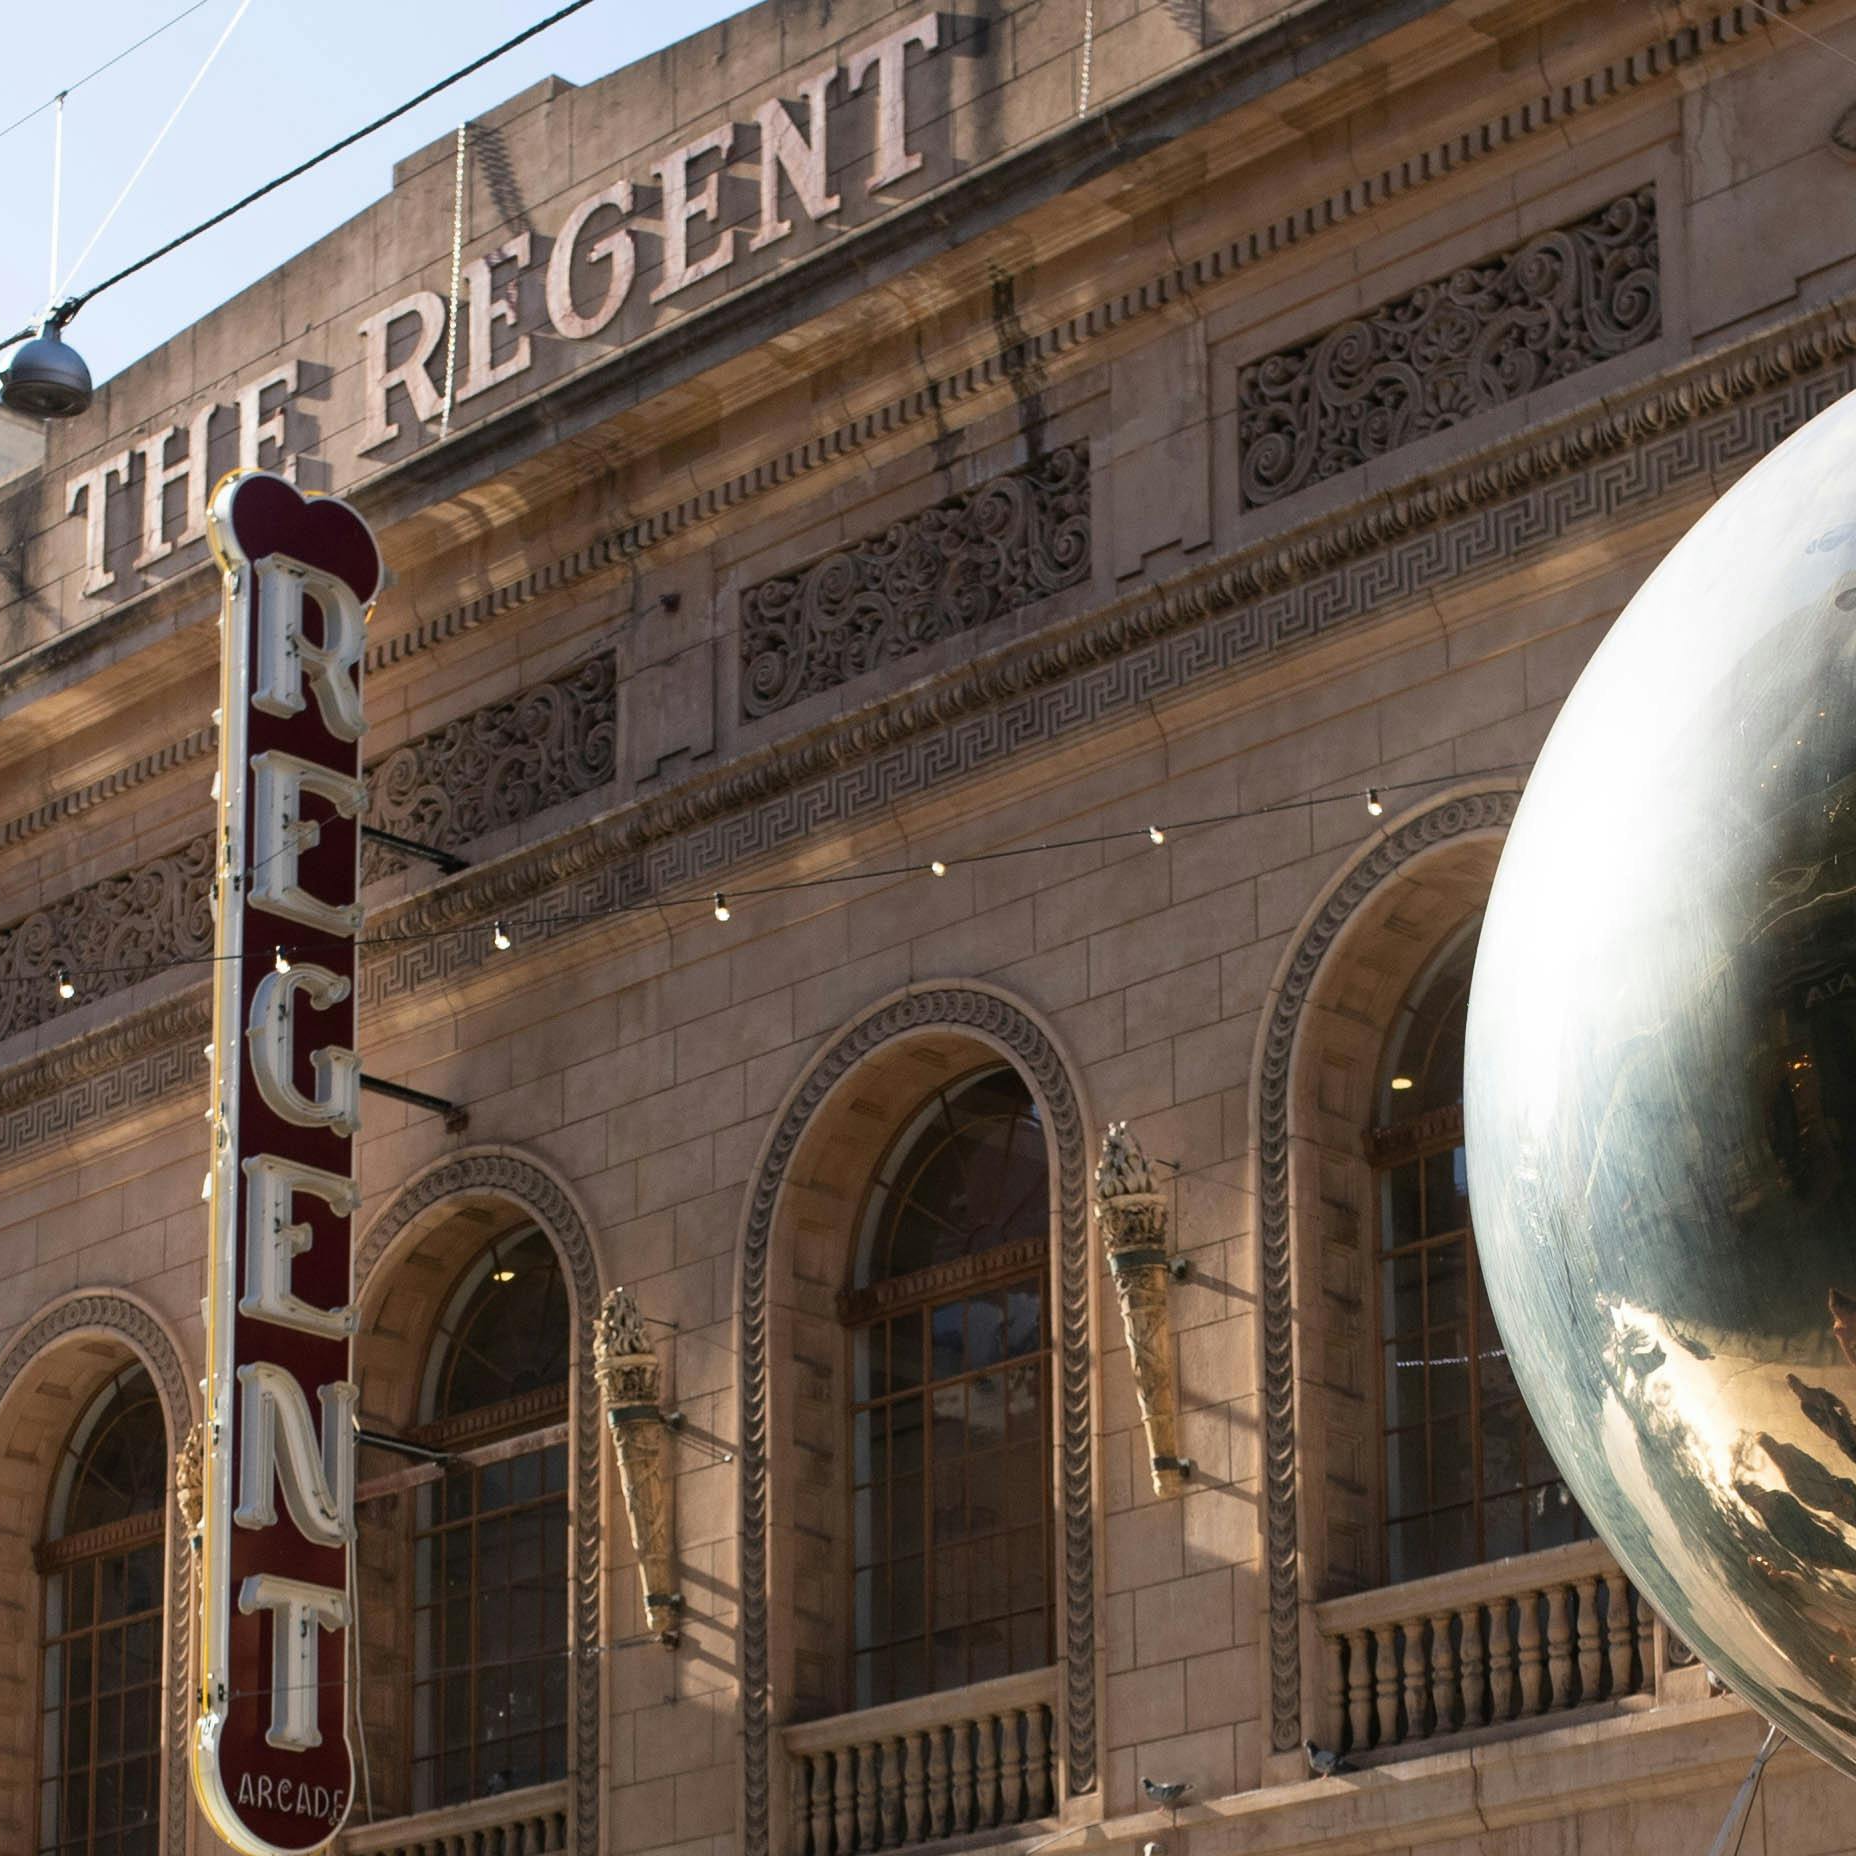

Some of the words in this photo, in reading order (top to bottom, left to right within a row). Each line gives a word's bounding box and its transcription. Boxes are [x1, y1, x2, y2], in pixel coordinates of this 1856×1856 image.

[65, 360, 299, 597] THE
[355, 12, 939, 458] REGENT
[235, 552, 368, 1751] REGENT
[237, 1771, 345, 1826] ARCADE
